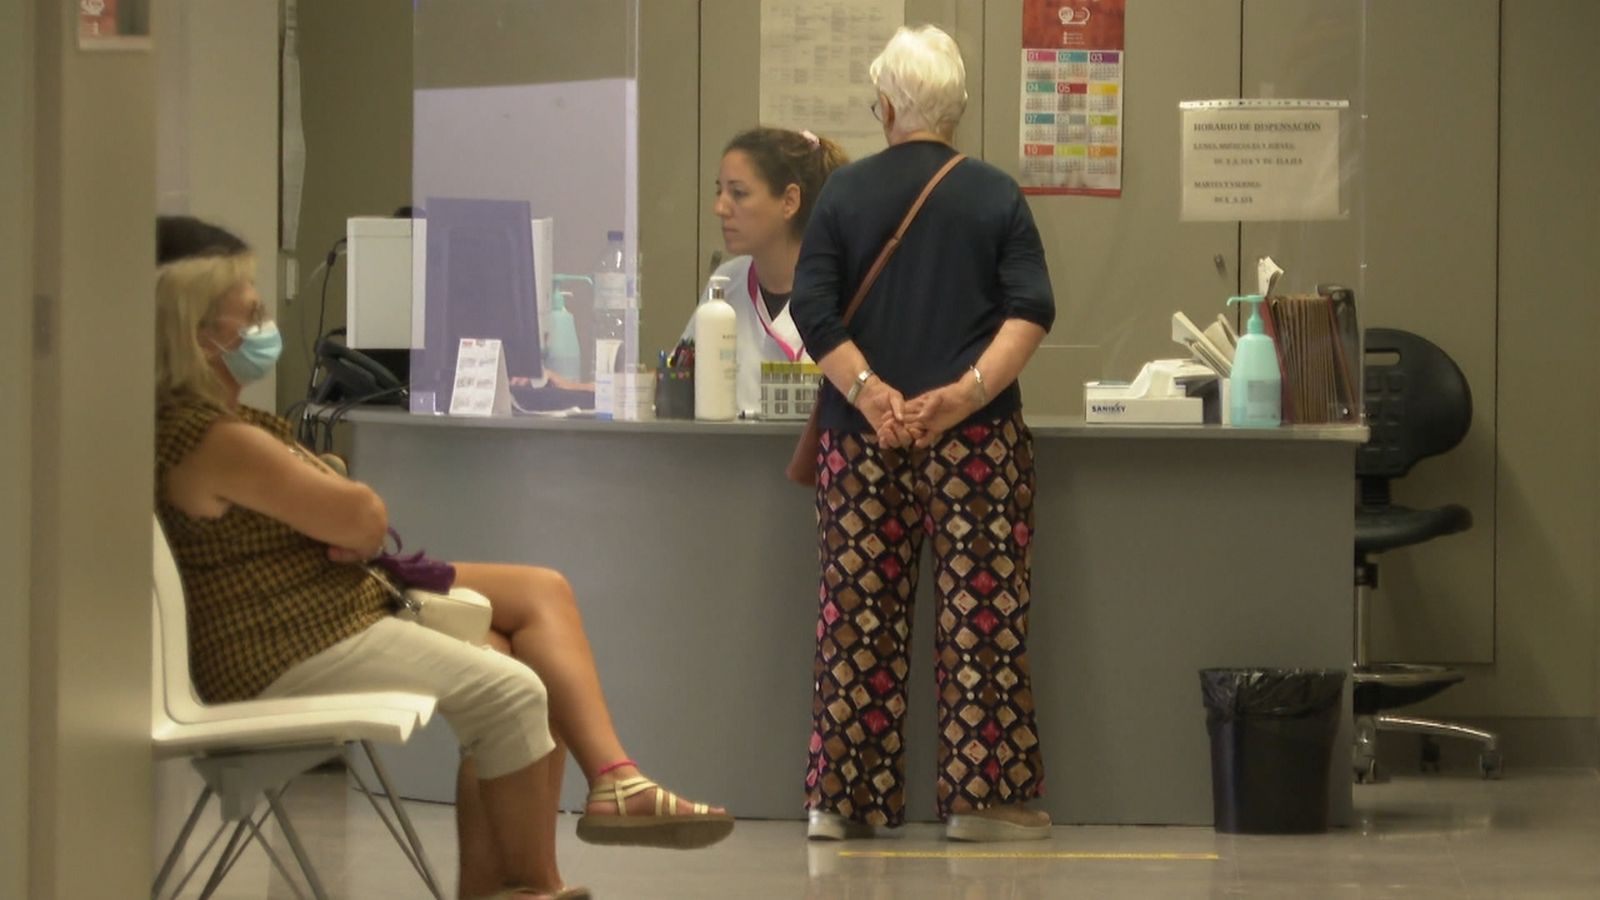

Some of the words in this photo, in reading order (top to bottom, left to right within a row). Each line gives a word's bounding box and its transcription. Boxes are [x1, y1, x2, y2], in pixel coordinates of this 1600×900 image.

[1091, 53, 1103, 62] 03
[1027, 84, 1039, 92] 04
[1193, 122, 1237, 132] HORARIO
[1239, 122, 1251, 132] DE
[1253, 121, 1321, 133] DISPENSACIÓN
